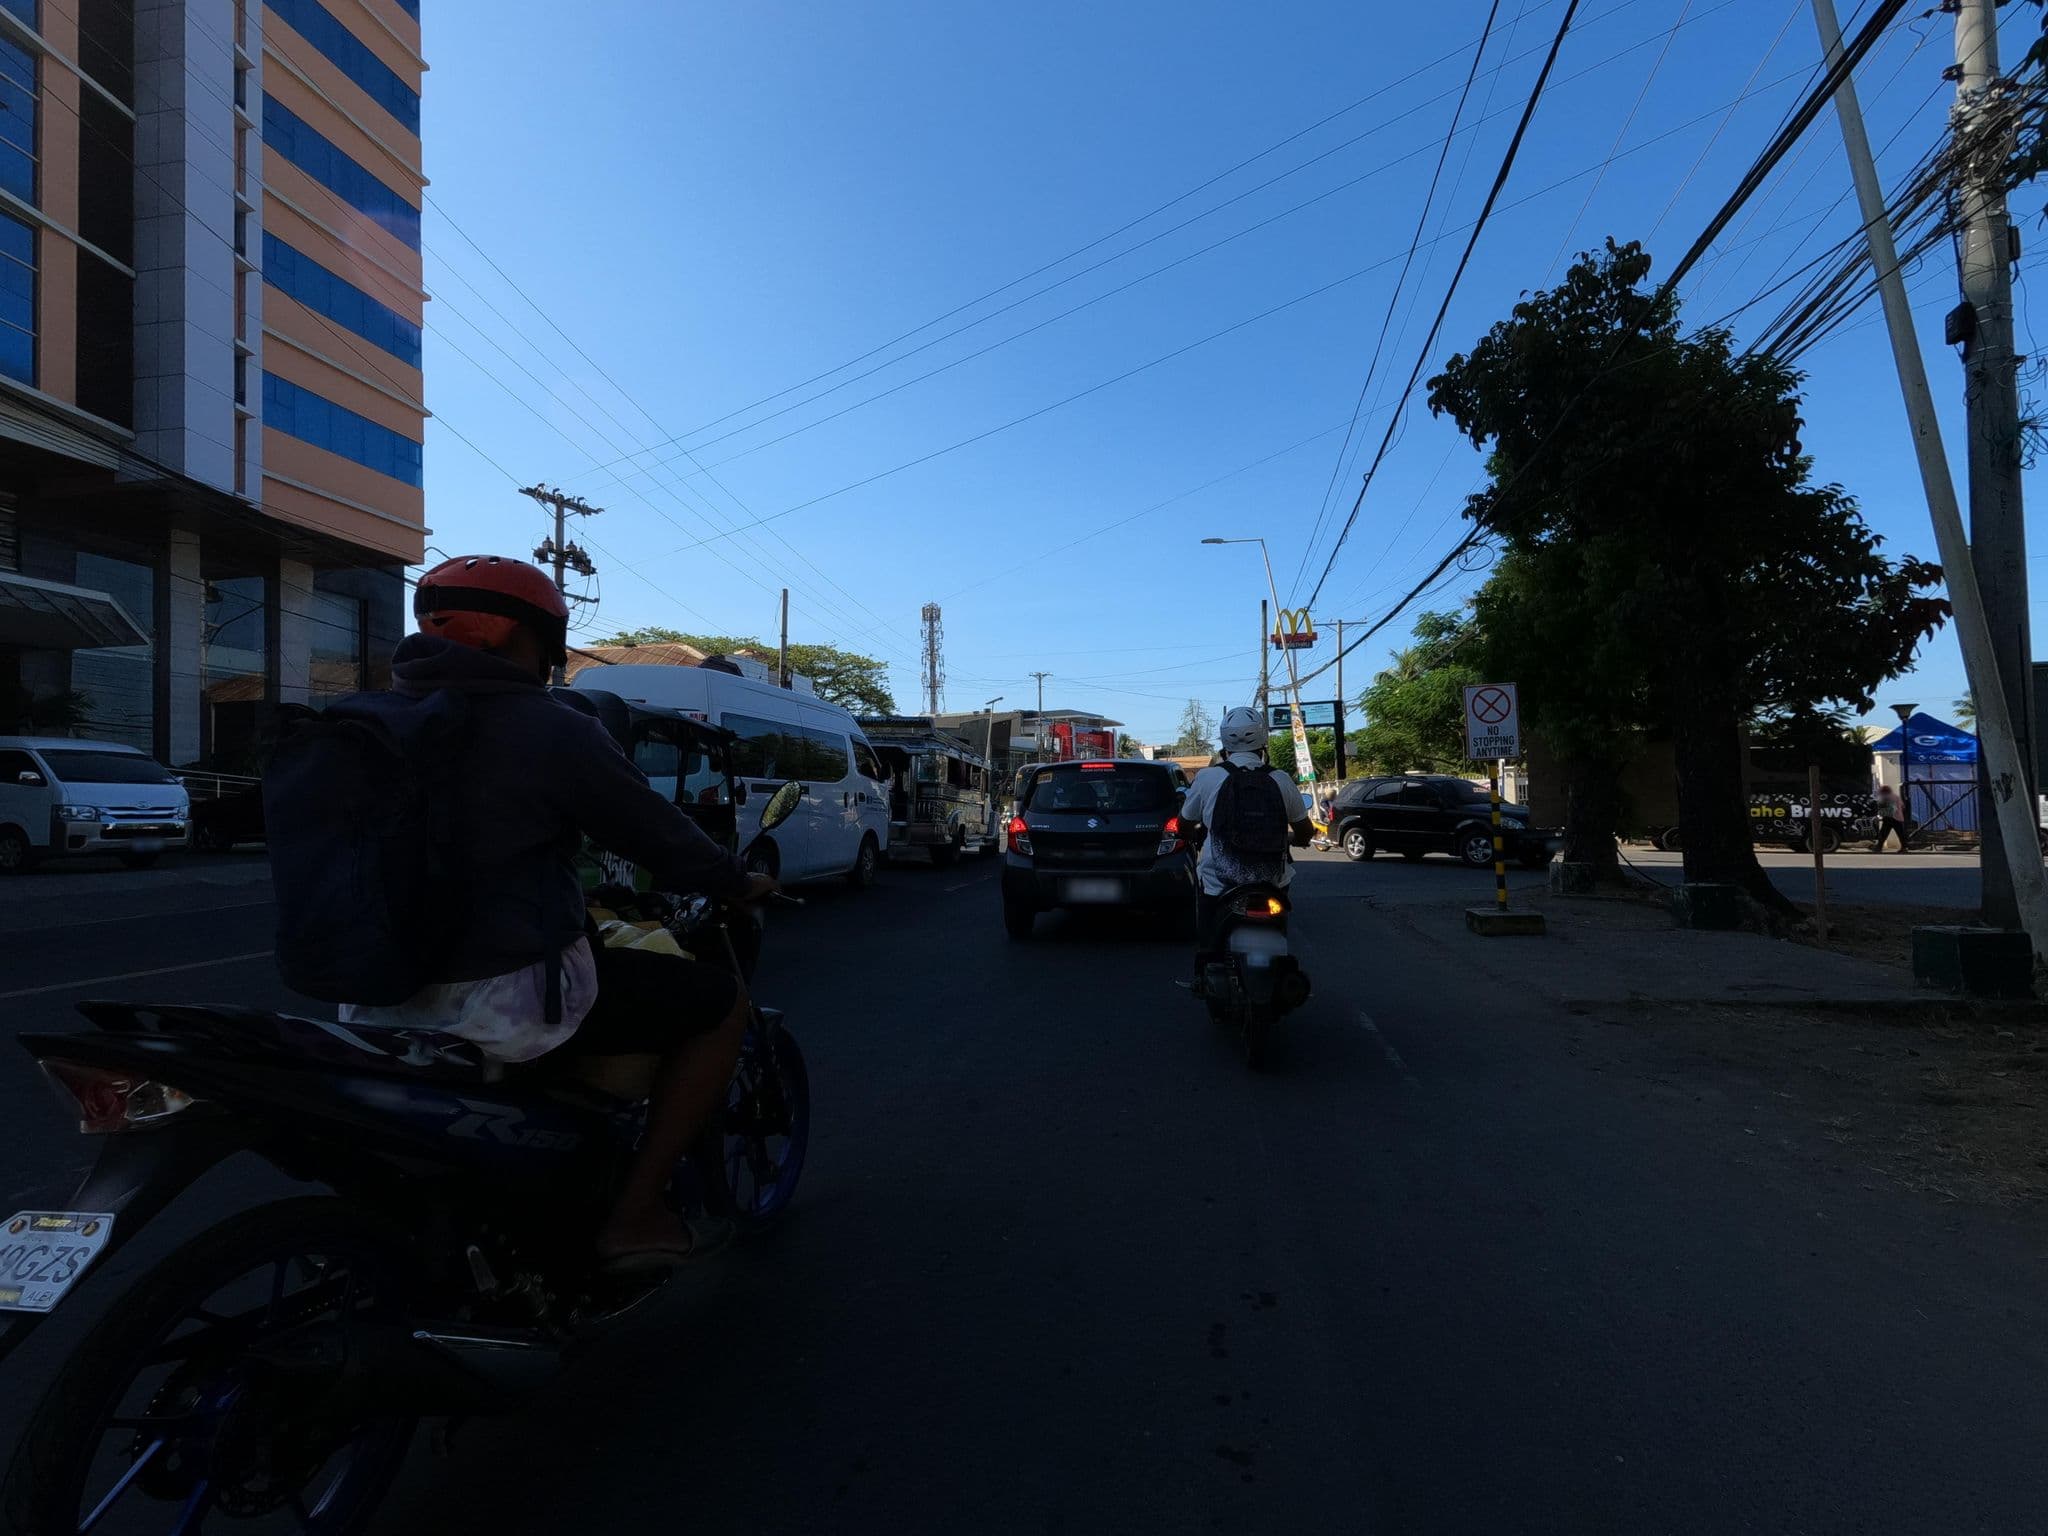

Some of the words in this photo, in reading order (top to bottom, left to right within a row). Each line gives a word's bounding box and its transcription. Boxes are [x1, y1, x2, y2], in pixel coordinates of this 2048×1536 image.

[1487, 725, 1500, 736] NO
[1472, 735, 1515, 747] STOPPING
[1475, 745, 1514, 757] ANYTIME
